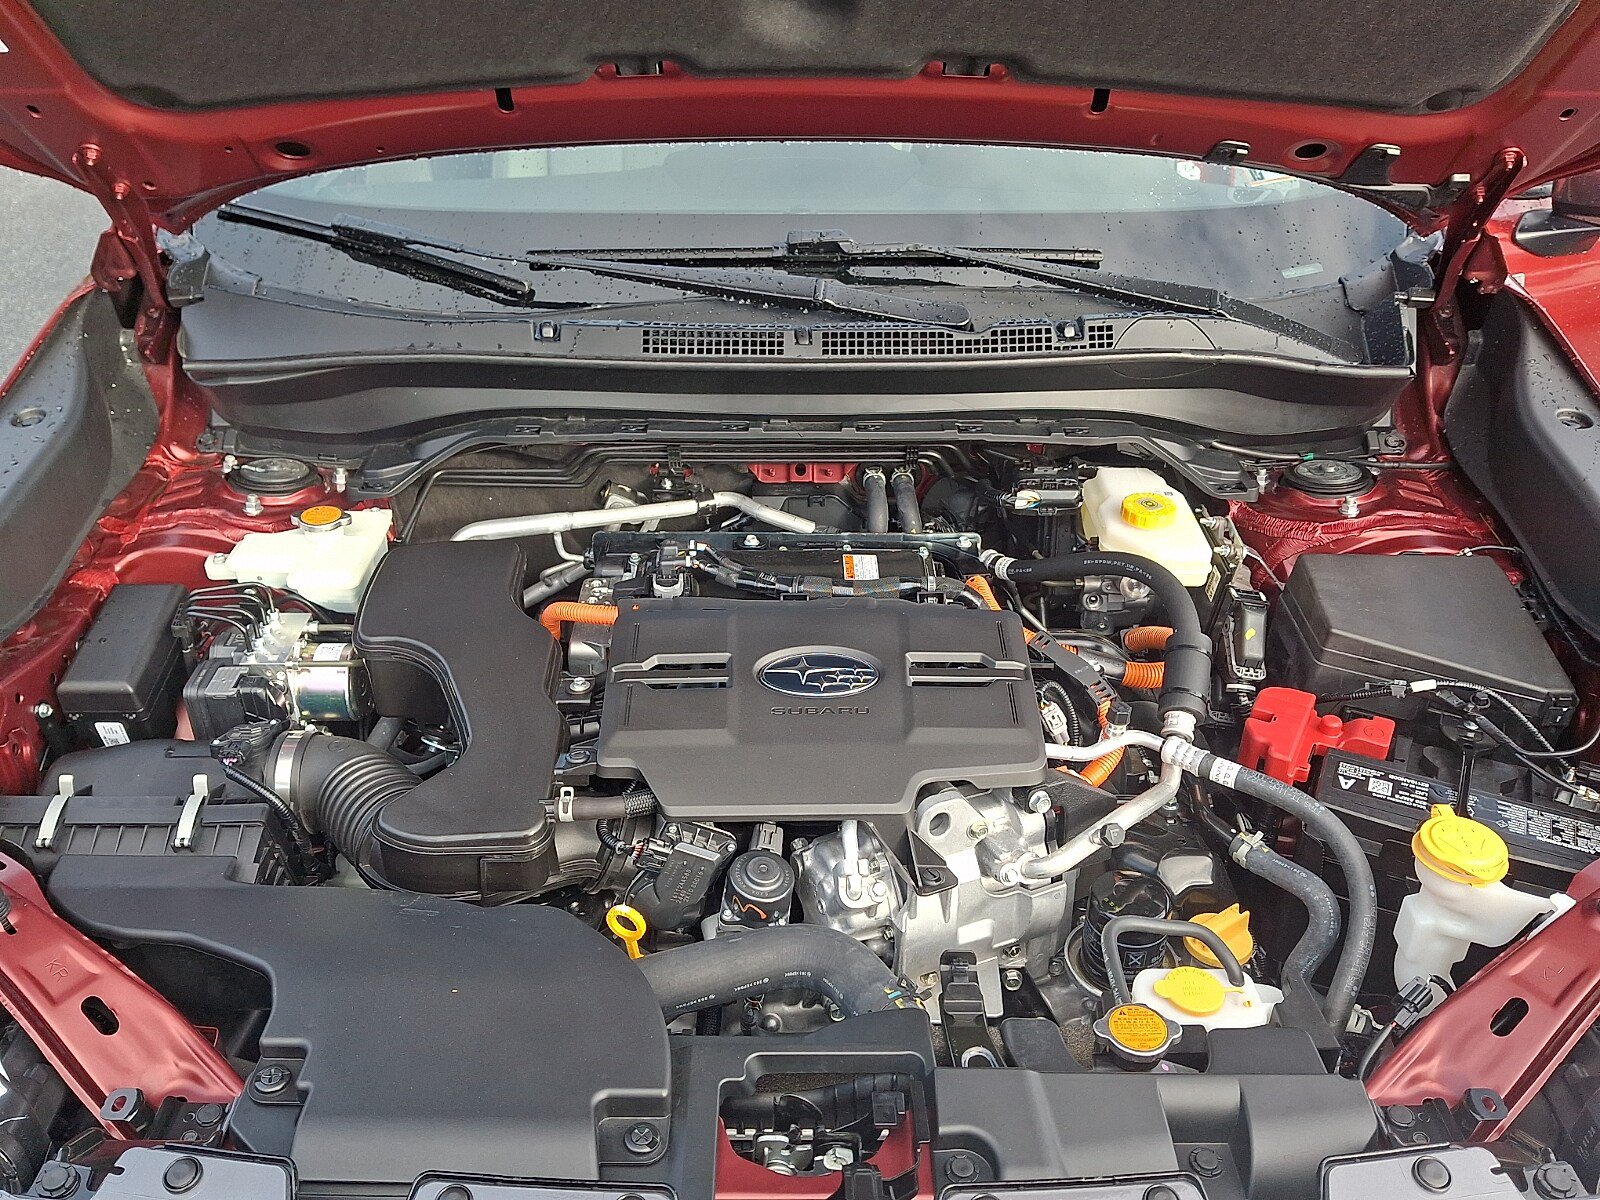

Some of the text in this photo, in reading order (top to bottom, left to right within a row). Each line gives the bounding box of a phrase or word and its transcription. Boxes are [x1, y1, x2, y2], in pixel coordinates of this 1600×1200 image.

[770, 706, 871, 715] SUBARU
[1338, 775, 1356, 789] A
[45, 958, 69, 982] KR
